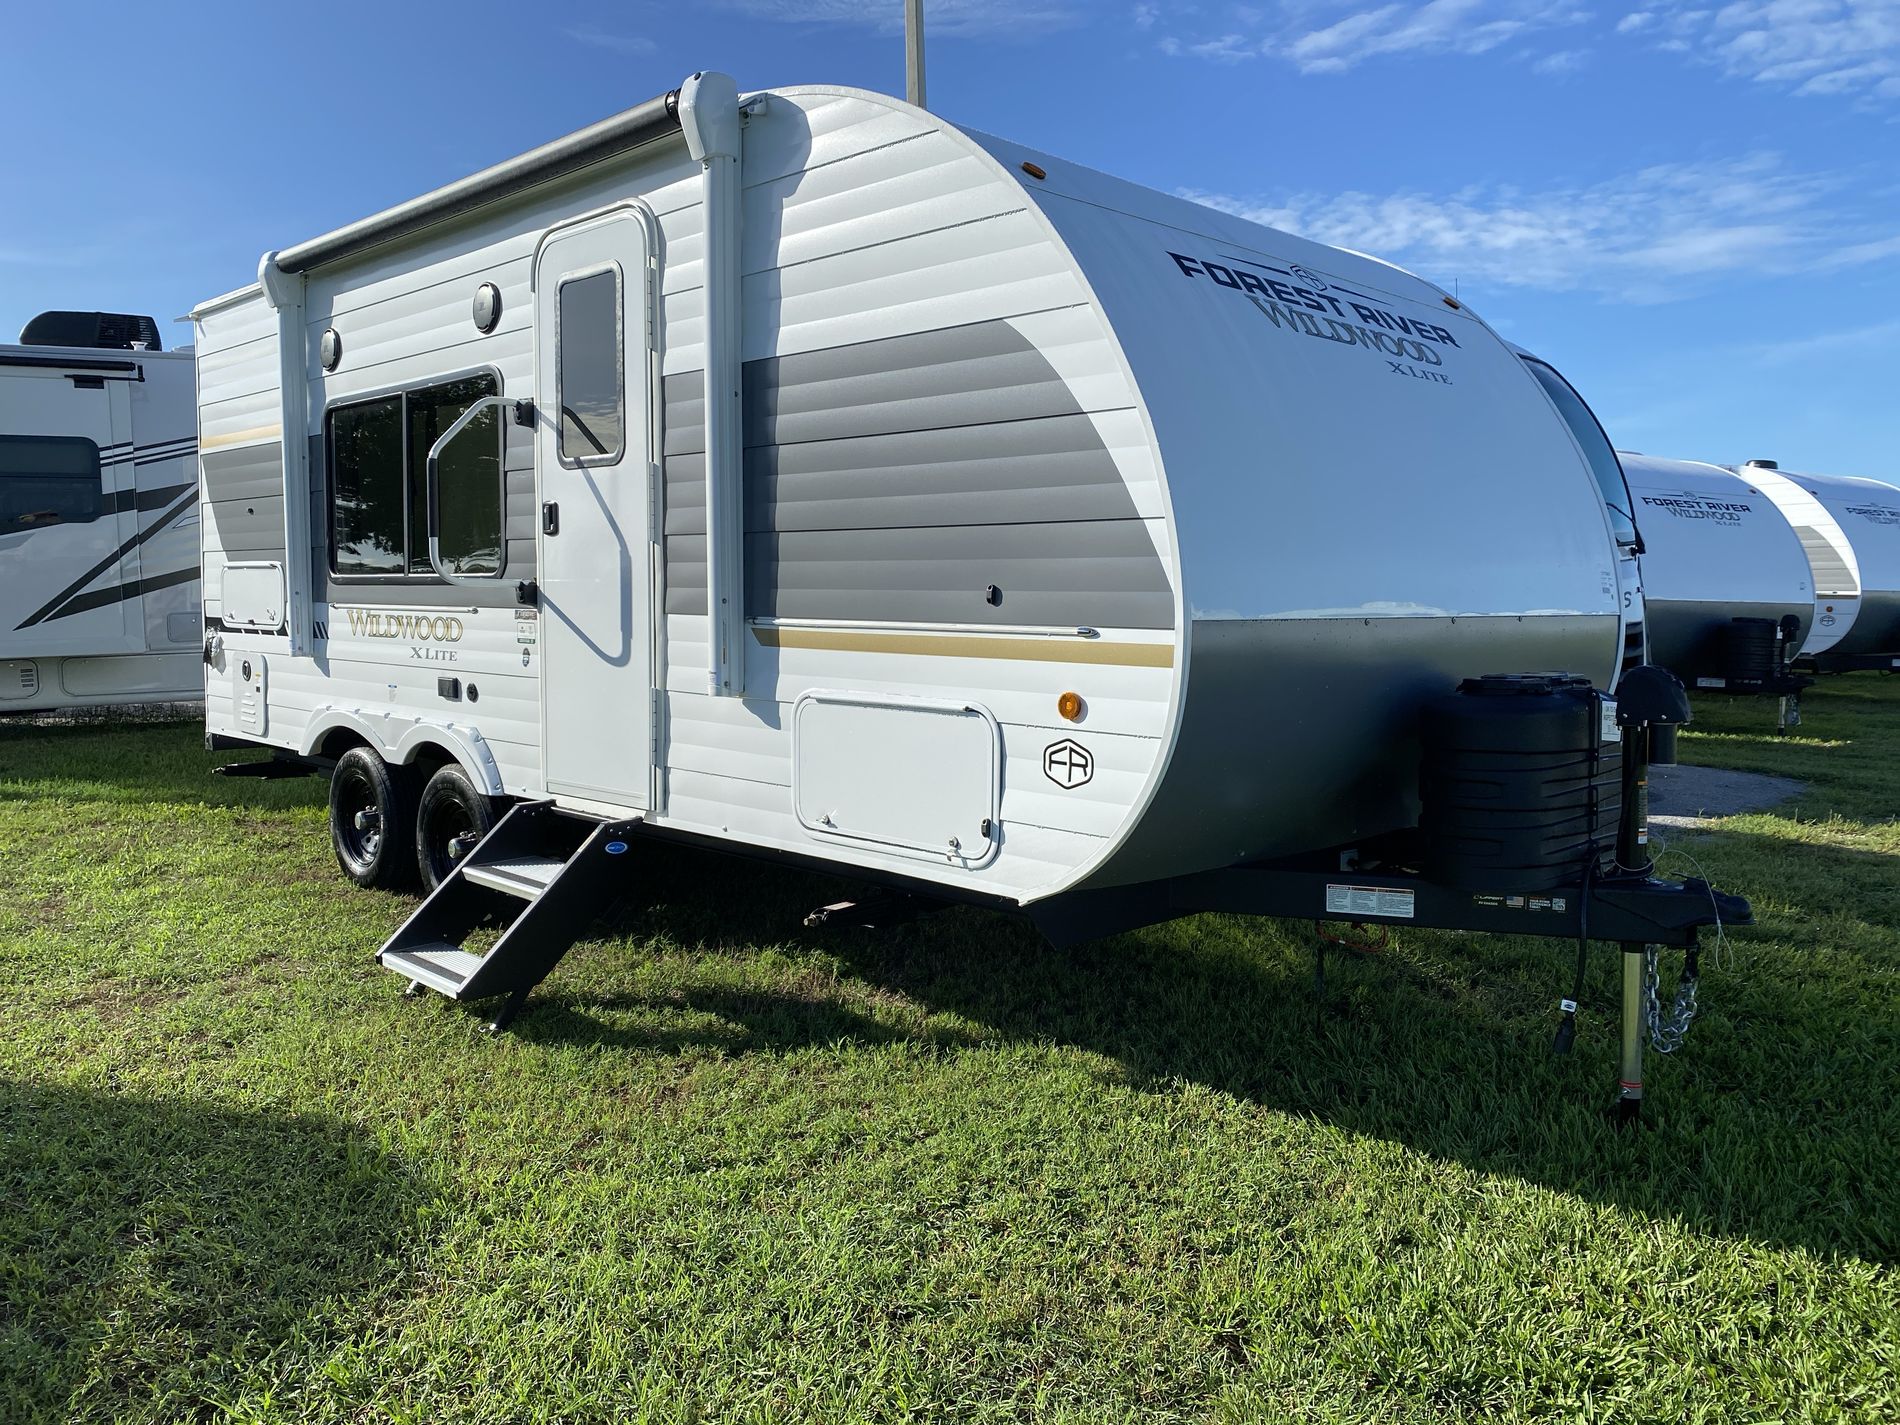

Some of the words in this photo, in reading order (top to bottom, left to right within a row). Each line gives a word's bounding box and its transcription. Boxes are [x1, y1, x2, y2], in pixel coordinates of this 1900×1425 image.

[1166, 251, 1346, 317] FOREST
[1347, 302, 1463, 349] RIVER
[1243, 293, 1443, 367] WILDWOOD
[1641, 496, 1702, 510] FOREST
[1704, 502, 1752, 513] RIVER
[1665, 507, 1741, 522] WILDWOOD
[347, 609, 464, 642] WILDWOOD
[424, 649, 458, 662] LITE
